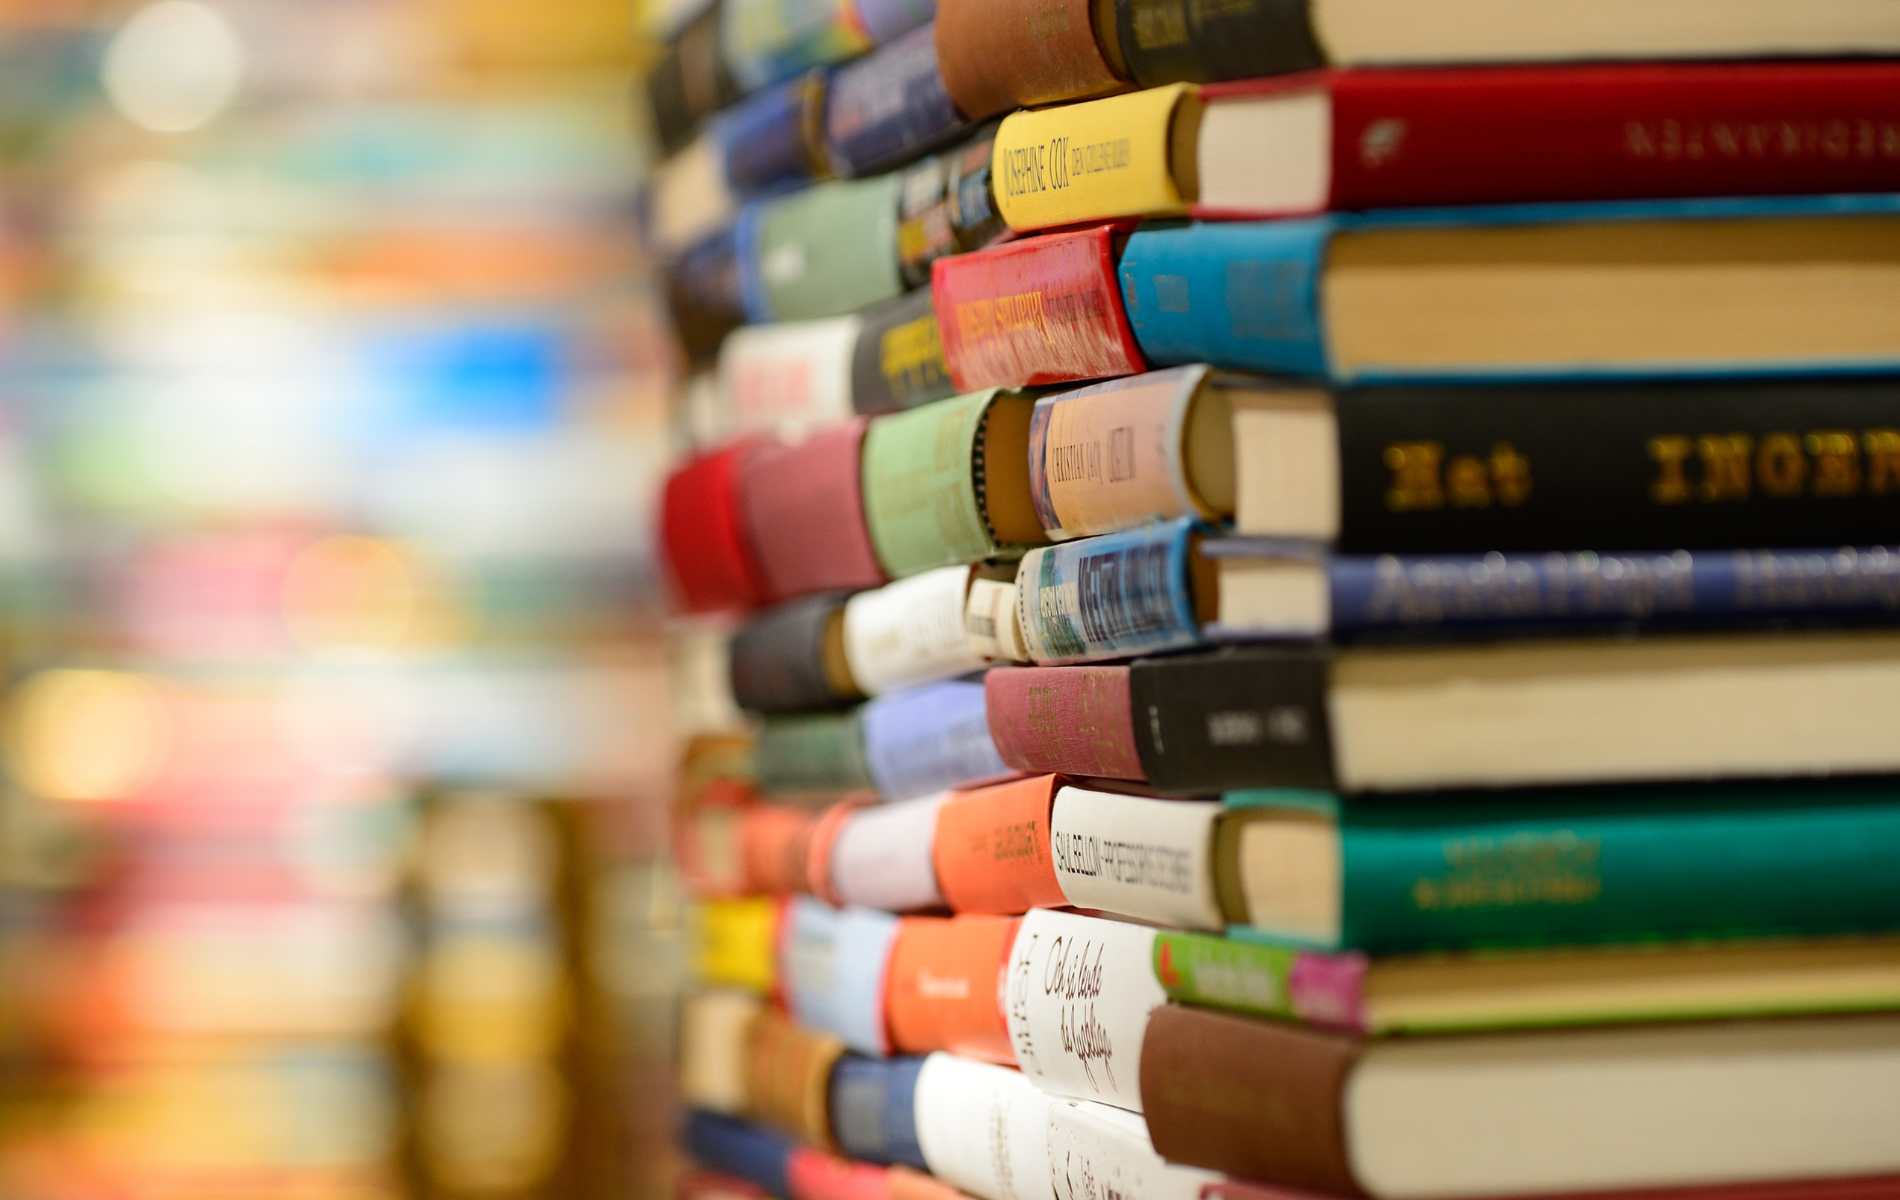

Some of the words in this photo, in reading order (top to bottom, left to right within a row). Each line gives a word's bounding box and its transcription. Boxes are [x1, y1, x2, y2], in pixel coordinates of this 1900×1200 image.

[1003, 144, 1046, 208] JOSEPHINE
[1049, 136, 1069, 189] COX
[1055, 831, 1072, 874] SAUL
